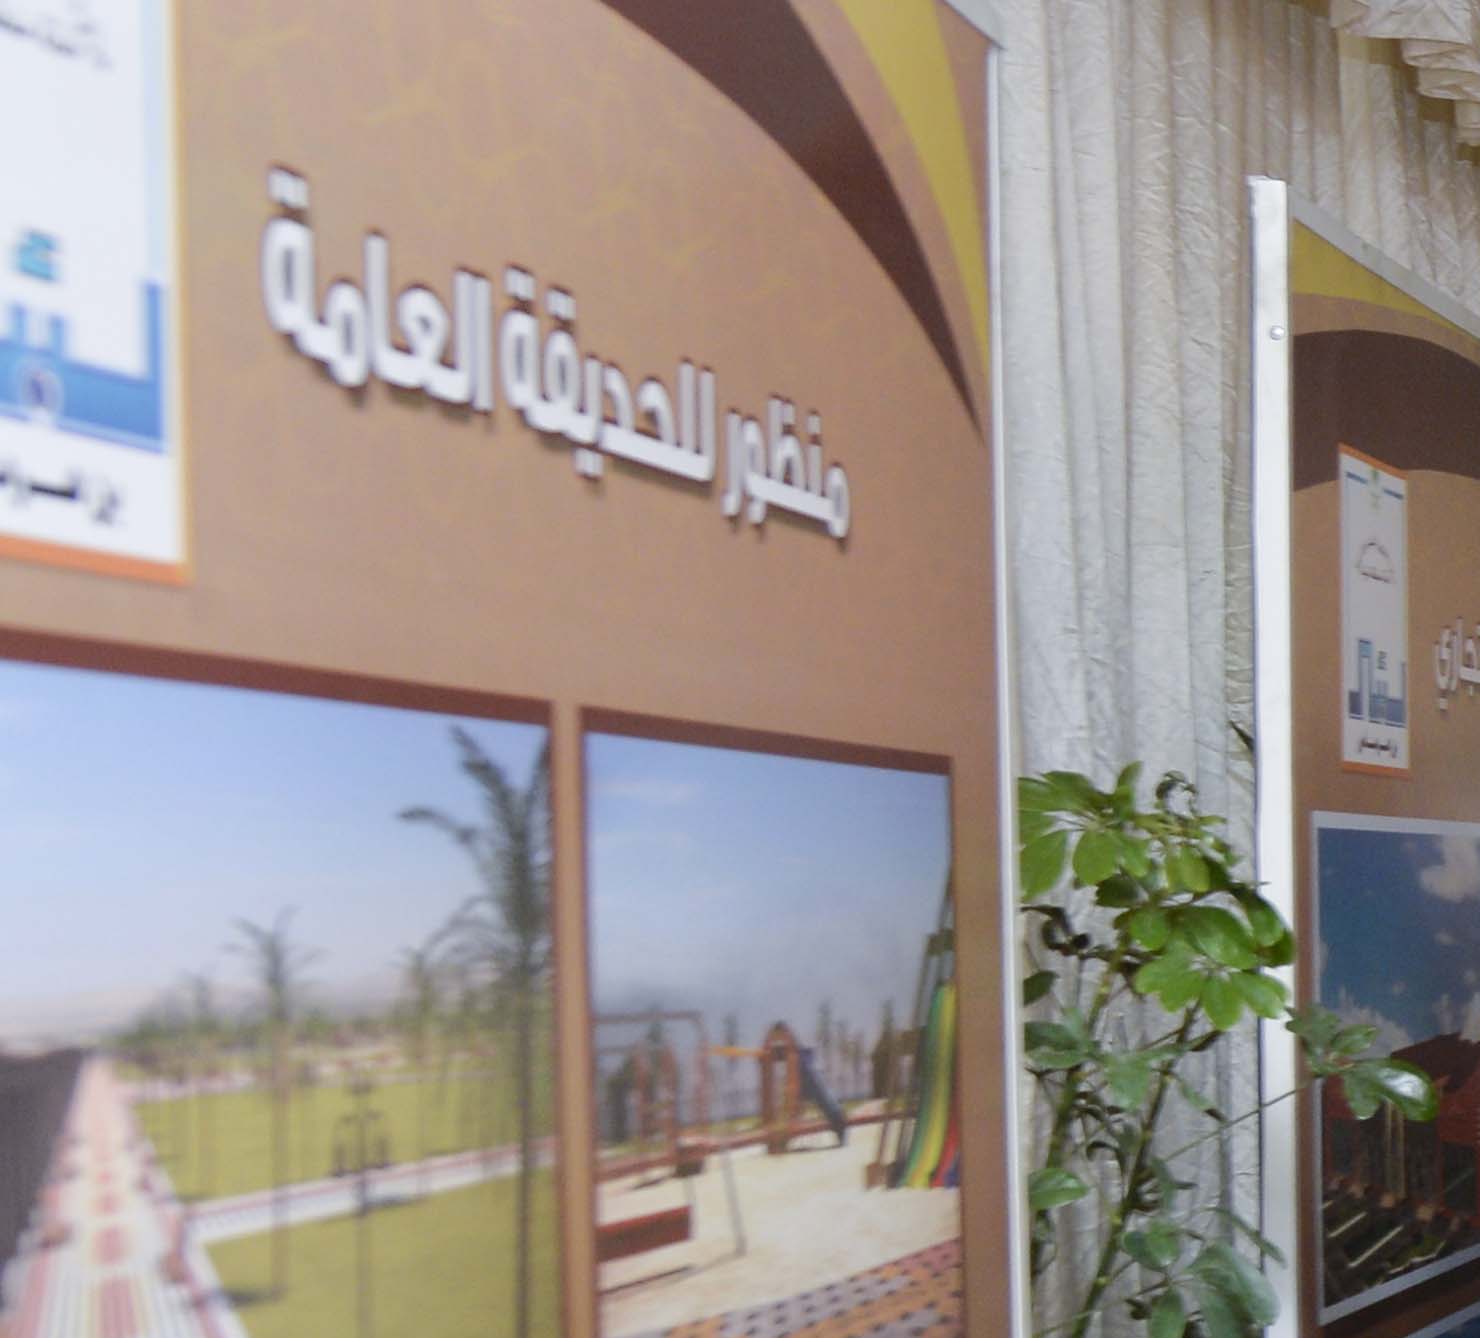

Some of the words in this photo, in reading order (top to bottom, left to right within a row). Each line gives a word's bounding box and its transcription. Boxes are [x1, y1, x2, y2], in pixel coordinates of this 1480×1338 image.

[262, 165, 496, 411] العامة
[499, 264, 716, 480] للحديقة
[721, 393, 848, 538] منظور
